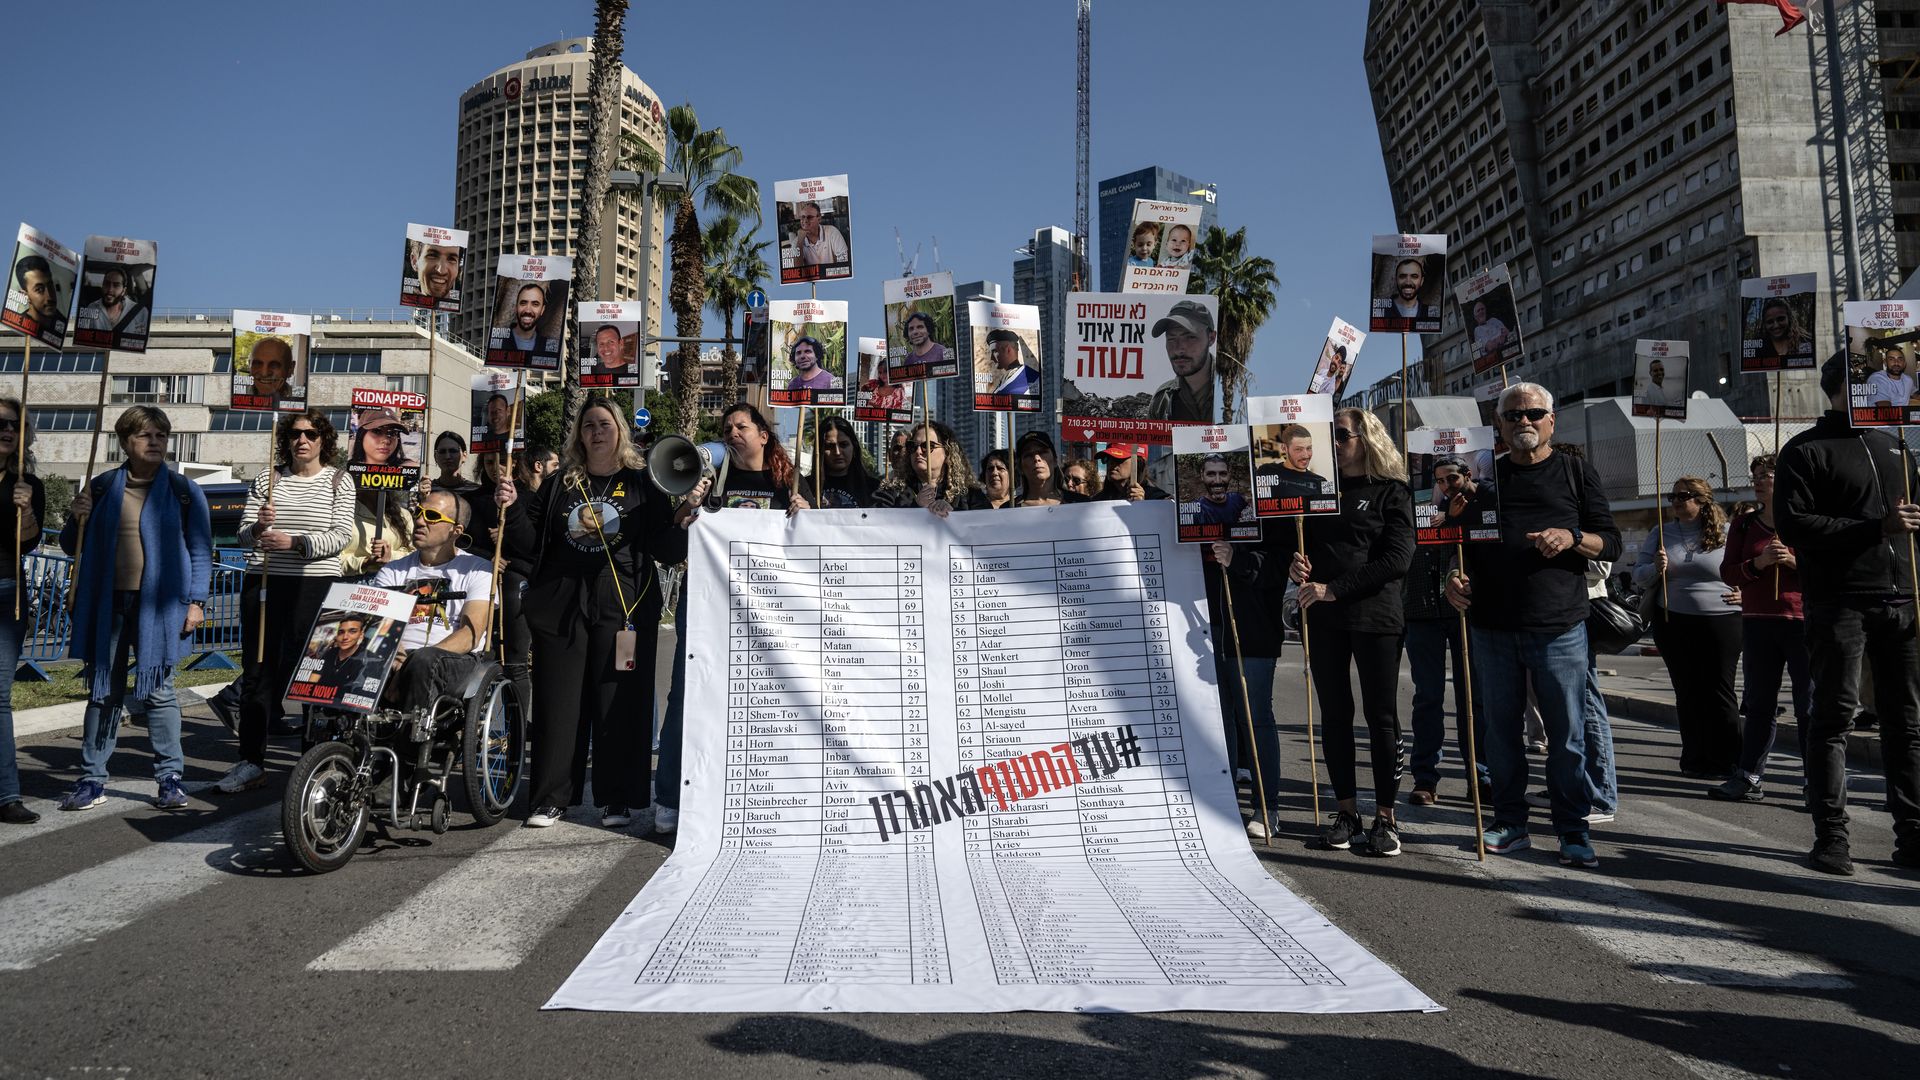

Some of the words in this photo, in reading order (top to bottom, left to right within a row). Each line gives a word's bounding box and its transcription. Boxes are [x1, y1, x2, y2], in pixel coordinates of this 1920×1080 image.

[1100, 188, 1117, 197] ISRAEL
[1119, 182, 1141, 192] CANADA
[1206, 190, 1216, 203] EY
[783, 258, 794, 268] HIM
[783, 268, 800, 279] HOME
[8, 289, 29, 305] BRING
[6, 299, 18, 311] HIM
[1077, 304, 1126, 319] שוכחים
[1130, 302, 1146, 319] לא
[3, 310, 21, 325] HOME
[492, 328, 510, 338] BRING
[1078, 322, 1114, 342] איתי
[1120, 323, 1145, 343] את
[581, 358, 597, 366] BRING
[1077, 346, 1144, 379] בעזה
[234, 376, 254, 385] BRING
[772, 370, 792, 380] BRING
[771, 380, 784, 389] HIM
[1851, 384, 1877, 395] BRING
[355, 391, 425, 406] KIDNAPPED
[771, 391, 791, 401] HOME
[1852, 396, 1867, 407] HIM
[1853, 409, 1875, 420] HOME
[361, 474, 403, 487] NOW!!
[1256, 475, 1279, 487] BRING
[1257, 487, 1271, 498] HIM
[1180, 503, 1200, 513] BRING
[1258, 499, 1278, 510] HOME
[1281, 496, 1302, 508] NOW!
[1416, 505, 1438, 516] BRING
[1180, 515, 1193, 524] HIM
[1417, 517, 1430, 527] HIM
[1181, 526, 1200, 536] HOME
[1203, 524, 1223, 536] NOW!
[1418, 529, 1438, 540] HOME
[751, 559, 786, 570] Yehoud
[823, 562, 848, 572] Arbel
[903, 562, 915, 571] 29
[952, 561, 963, 571] 51
[976, 559, 1010, 571] Angrest
[1058, 556, 1085, 565] Matan
[1143, 551, 1154, 560] 22
[736, 572, 742, 581] 2
[750, 572, 778, 581] Cunio
[823, 576, 845, 585] Ariel
[904, 576, 915, 584] 27
[952, 575, 964, 584] 52
[976, 574, 996, 583] Idan
[1058, 568, 1088, 578] Tsachi
[1144, 564, 1156, 573] 50
[736, 585, 741, 594] 3
[750, 586, 777, 595] Shtivi
[823, 589, 843, 598] Idan
[904, 589, 916, 598] 29
[955, 627, 966, 636] 56
[979, 626, 1006, 636] Siegel
[1062, 622, 1087, 631] Keith
[1090, 619, 1122, 629] Samuel
[1149, 617, 1161, 626] 65
[736, 655, 742, 663] 8
[751, 655, 763, 664] Or
[824, 655, 865, 664] Avinatan
[906, 656, 917, 664] 31
[956, 653, 968, 662] 58
[980, 652, 1019, 662] Wenkert
[1065, 649, 1090, 658] Omer
[1152, 644, 1163, 653] 23
[300, 658, 324, 671] BRING
[957, 681, 969, 690] 60
[982, 680, 1005, 689] Joshi
[1067, 676, 1091, 686] Bipin
[1155, 672, 1167, 681] 24
[290, 683, 313, 696] HOME
[314, 684, 337, 699] NOW!
[960, 722, 972, 731] 63
[984, 720, 1025, 731] Al-sayed
[1070, 717, 1105, 726] Hisham
[1160, 712, 1173, 722] 36
[732, 725, 744, 734] 13
[750, 724, 798, 734] Braslavski
[824, 724, 846, 733] Rom
[909, 724, 920, 732] 21
[732, 740, 743, 749] 14
[749, 739, 774, 748] Horn
[826, 738, 848, 747] Eitan
[910, 738, 921, 746] 38
[731, 769, 742, 778] 16
[749, 768, 770, 777] Mor
[826, 767, 850, 776] Eitan
[852, 766, 896, 776] Abraham
[910, 766, 923, 775] 24
[977, 742, 1082, 811] החטוף
[730, 798, 741, 807] 18
[748, 796, 808, 806] Steinbrecher
[824, 795, 856, 804] Doron
[869, 771, 986, 842] האחרון
[965, 819, 978, 828] 70
[991, 816, 1029, 826] Sharabi
[1082, 812, 1108, 821] Yossi
[1175, 808, 1188, 816] 53
